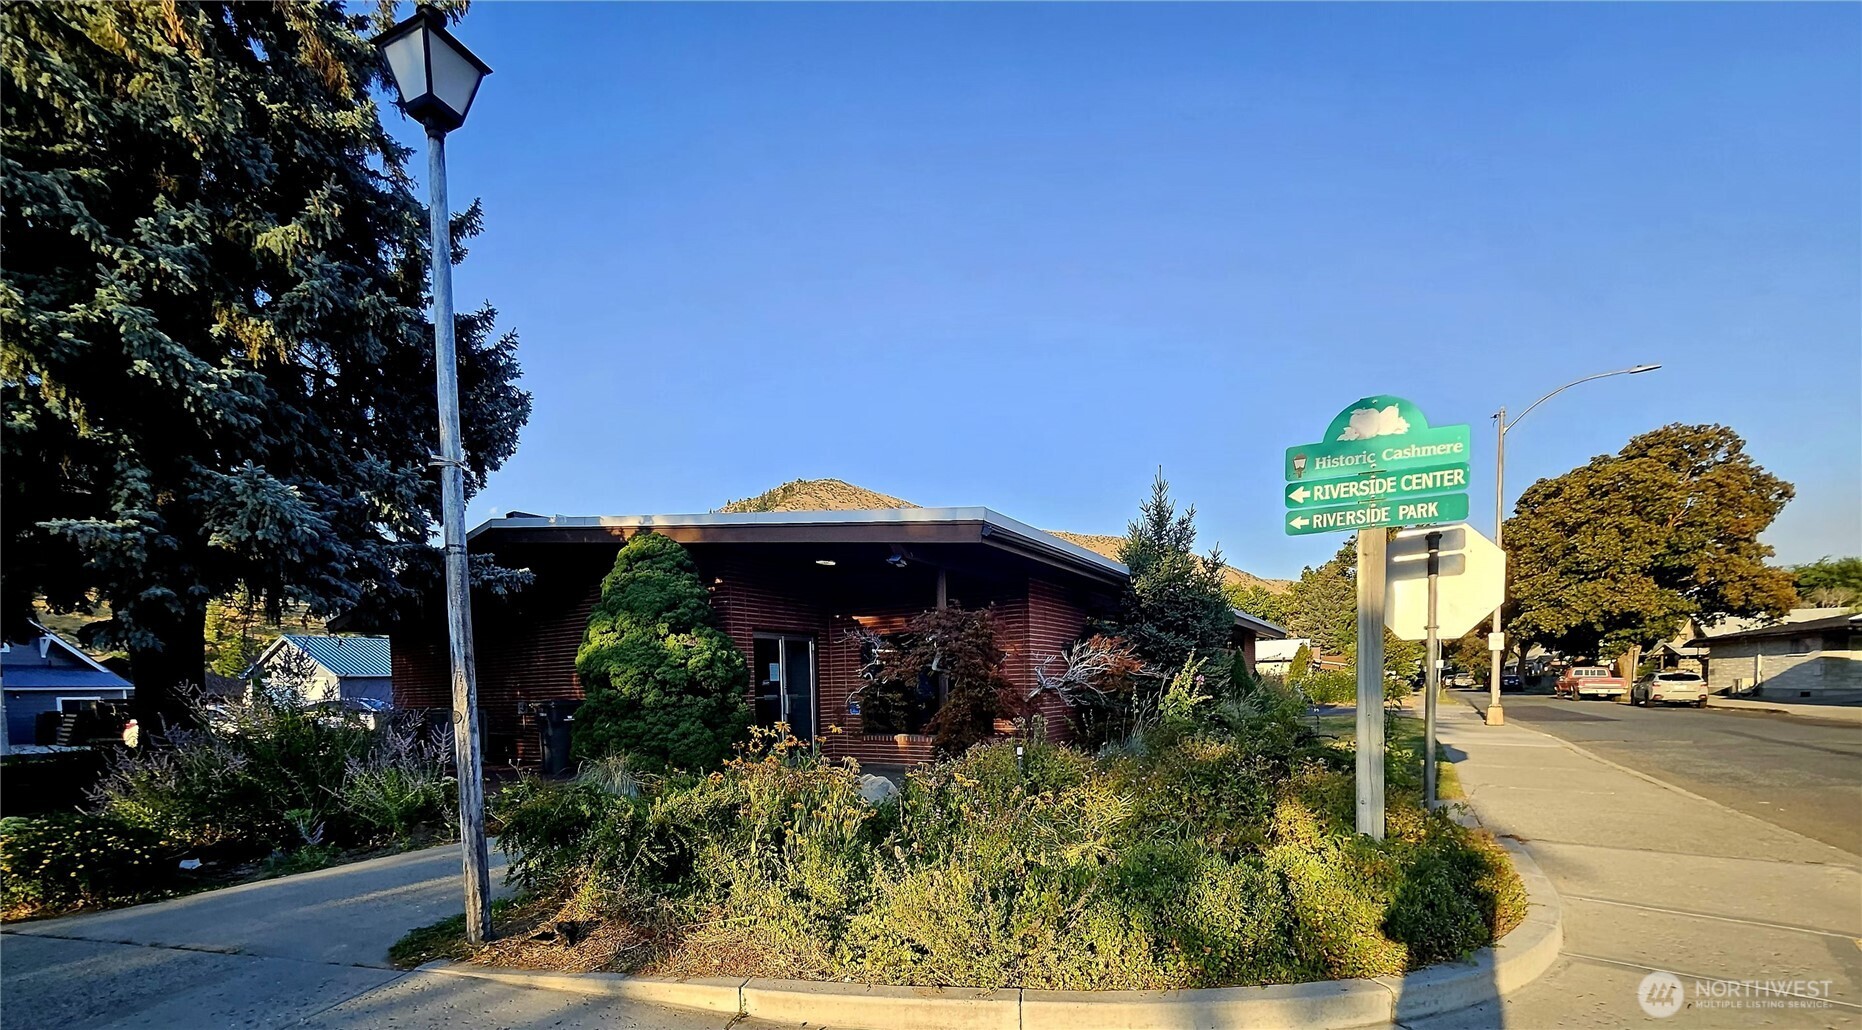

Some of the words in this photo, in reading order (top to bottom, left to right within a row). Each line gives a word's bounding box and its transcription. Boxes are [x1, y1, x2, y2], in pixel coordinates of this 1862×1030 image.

[1315, 451, 1376, 470] Historic
[1382, 441, 1464, 461] Cashmere
[1313, 477, 1396, 500] RIVERSIDE
[1401, 468, 1466, 490] CENTER
[1312, 506, 1391, 529] RIVERSIDE
[1399, 501, 1439, 520] PARK
